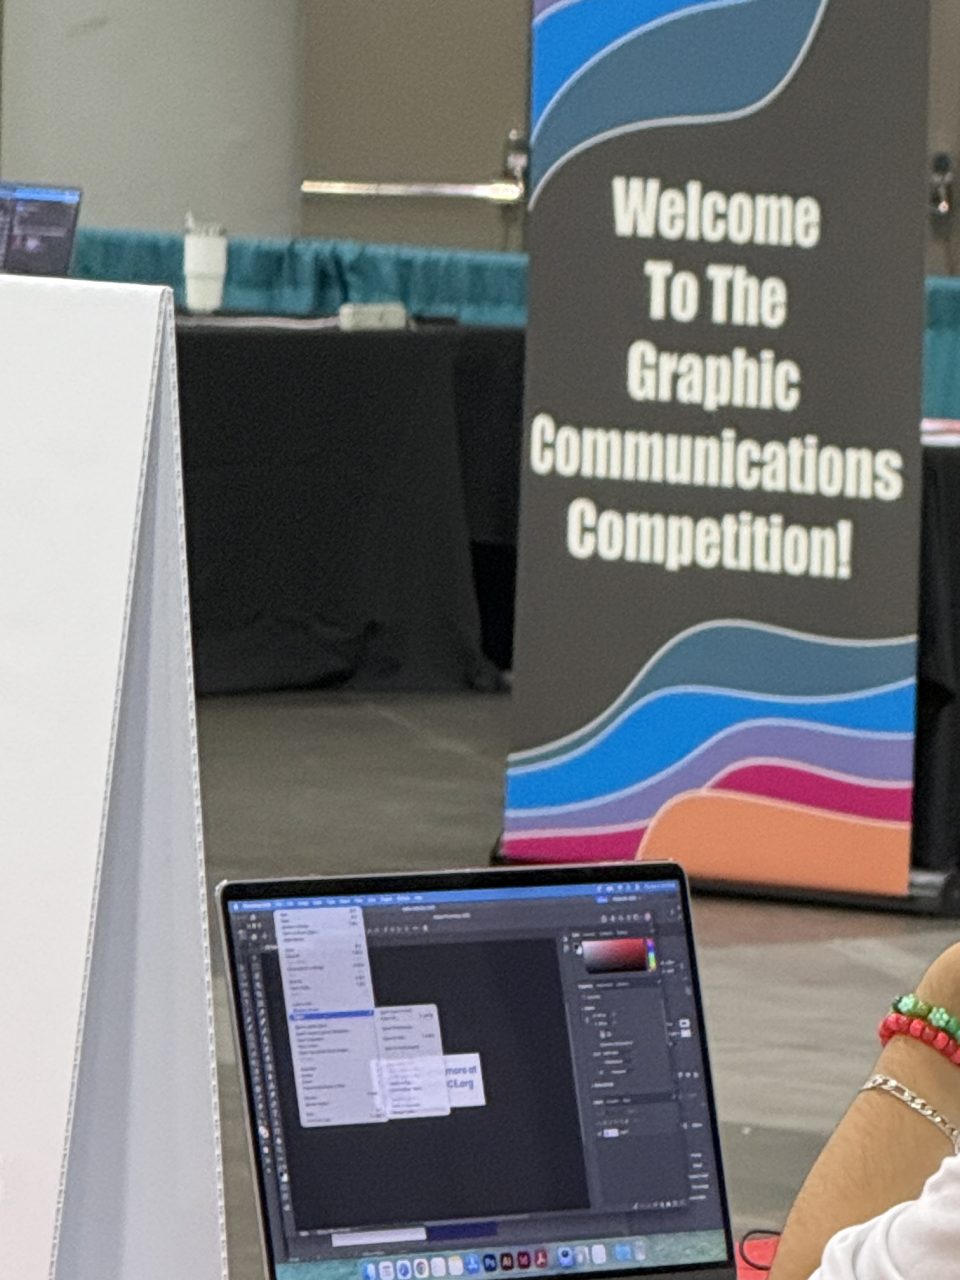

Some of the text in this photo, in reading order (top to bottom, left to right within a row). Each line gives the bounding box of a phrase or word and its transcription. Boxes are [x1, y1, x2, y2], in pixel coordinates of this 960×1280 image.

[612, 176, 821, 248] Welcome
[644, 260, 788, 329] To The
[627, 339, 801, 412] Graphic
[530, 413, 904, 501] Communications
[566, 497, 853, 580] Competition!
